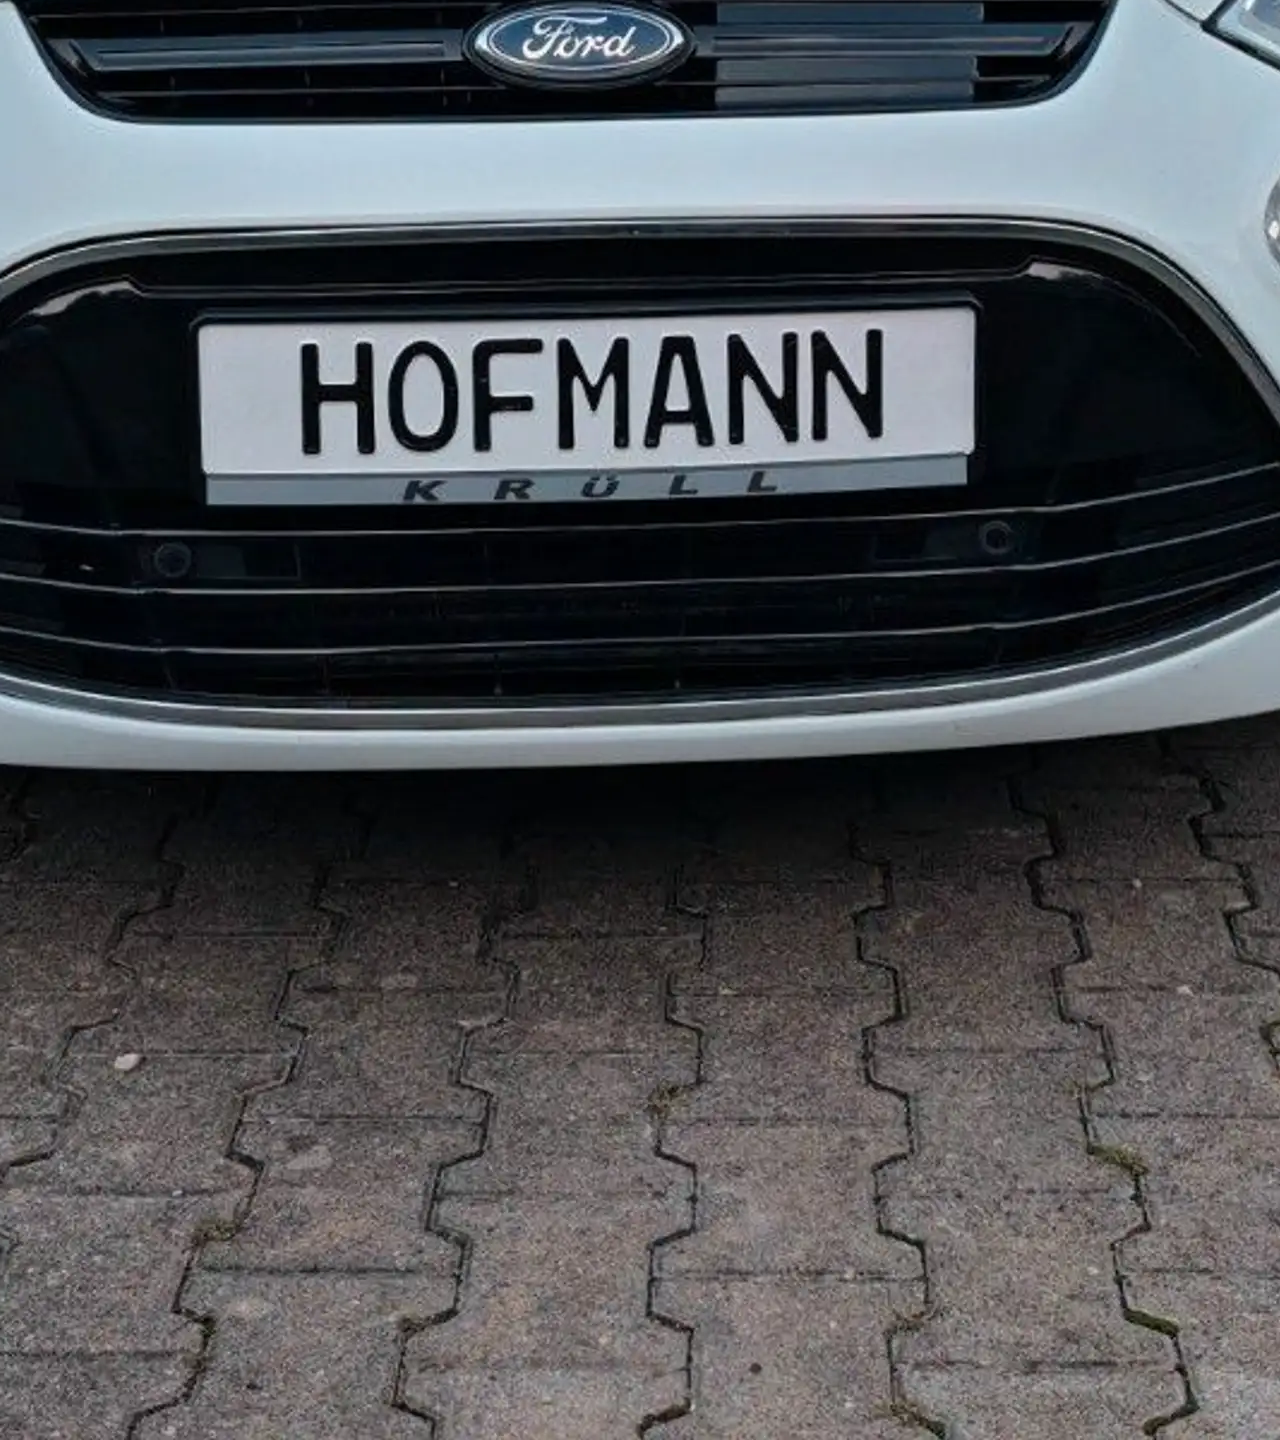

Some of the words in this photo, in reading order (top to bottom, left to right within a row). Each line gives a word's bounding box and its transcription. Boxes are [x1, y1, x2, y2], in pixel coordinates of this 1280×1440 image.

[523, 16, 636, 59] Ford
[301, 329, 883, 454] HOFMANN
[402, 470, 778, 502] KRÜLL
